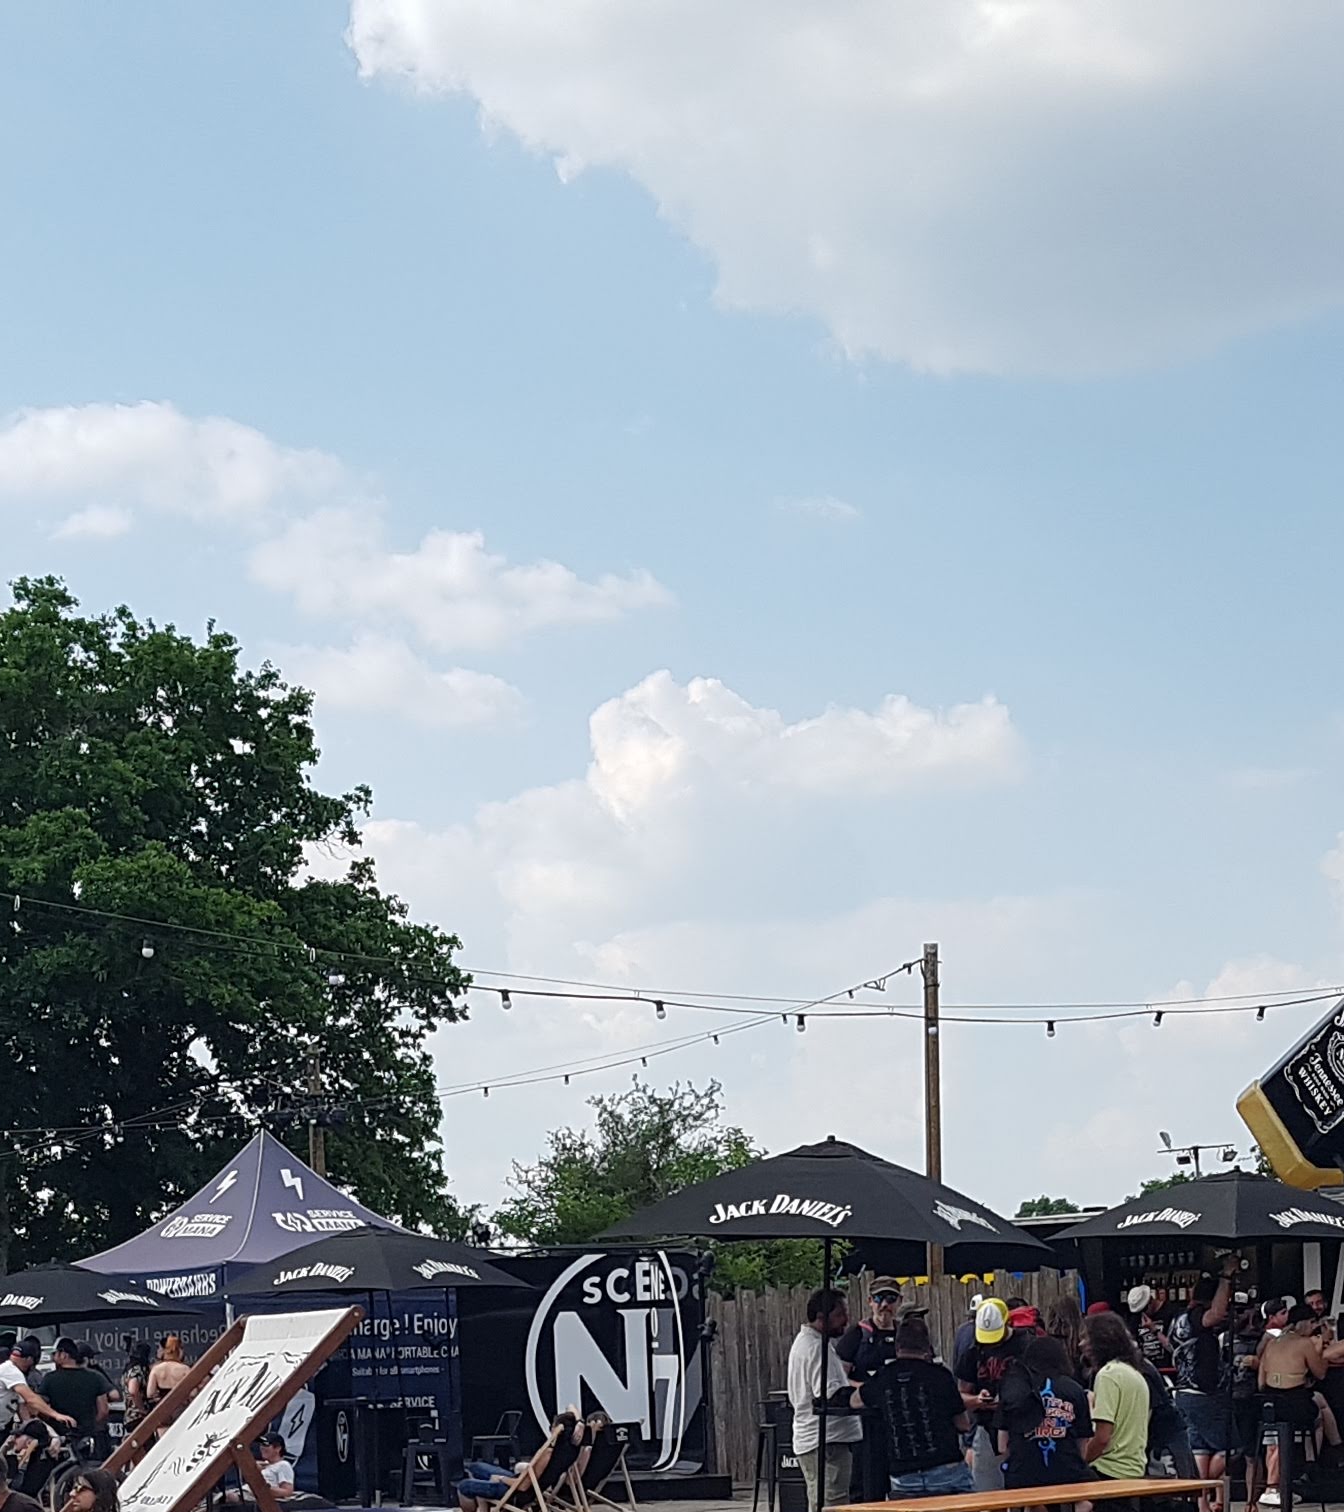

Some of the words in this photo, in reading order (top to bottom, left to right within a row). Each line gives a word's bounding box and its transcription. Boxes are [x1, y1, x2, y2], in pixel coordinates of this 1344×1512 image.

[1298, 1066, 1332, 1116] WHISKEY
[1310, 1053, 1343, 1106] Tennessee
[307, 1210, 355, 1220] SERVICE
[709, 1201, 767, 1224] JACK
[769, 1194, 852, 1227] DANIEL'S
[273, 1266, 312, 1285] JACK
[414, 1313, 458, 1339] Enjoy
